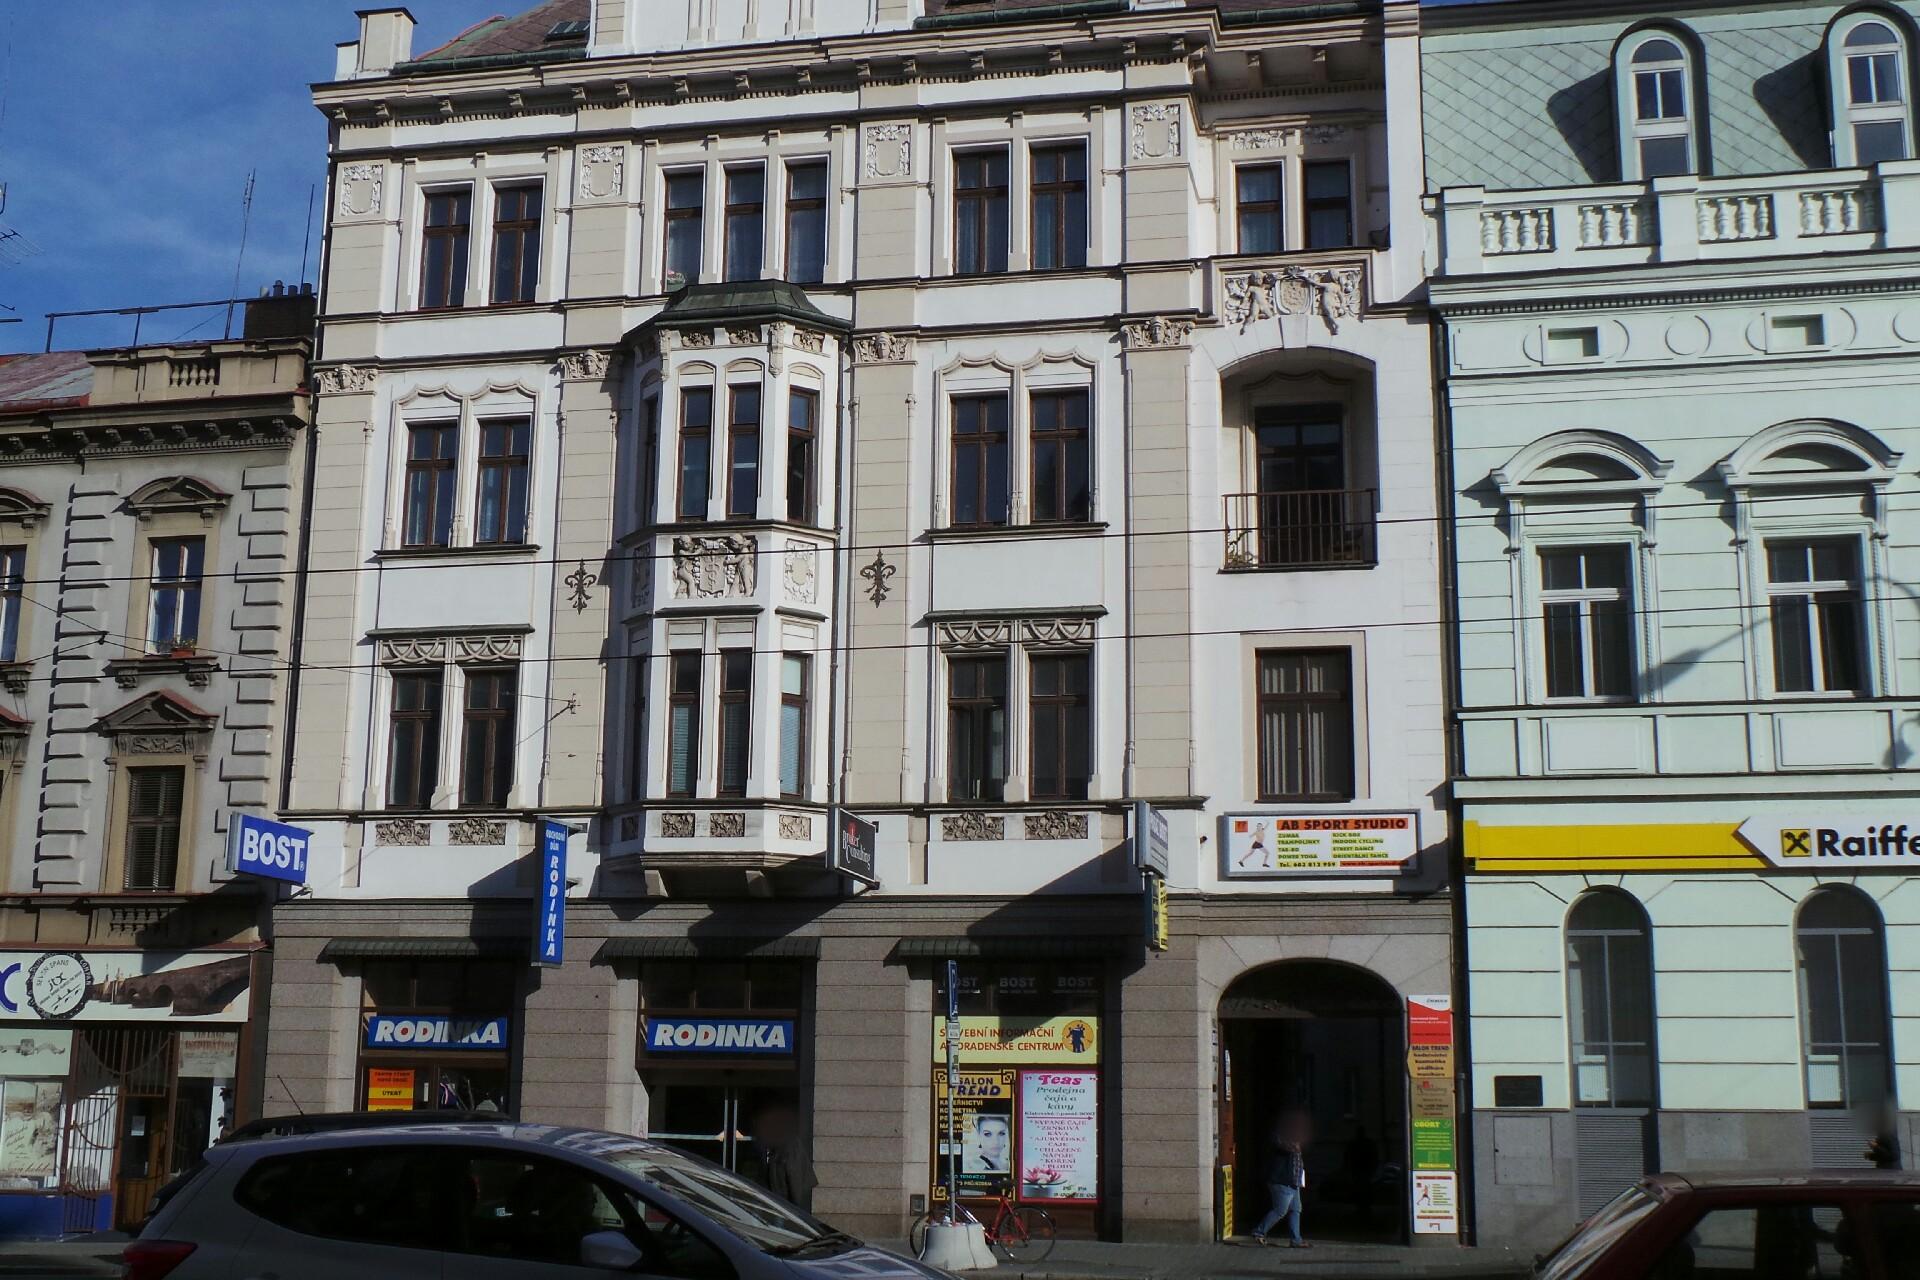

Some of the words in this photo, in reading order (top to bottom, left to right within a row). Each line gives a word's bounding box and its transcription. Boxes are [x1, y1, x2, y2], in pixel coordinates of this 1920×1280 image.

[1281, 820, 1299, 830] AB
[1304, 820, 1348, 830] SPORT
[1354, 819, 1406, 829] STUDIO
[243, 827, 306, 871] BOST
[546, 855, 559, 956] RODINKA
[1000, 976, 1036, 988] BOST
[1058, 976, 1095, 988] BOST
[375, 1020, 500, 1044] RODINKA
[654, 1023, 786, 1048] RODINKA
[939, 1026, 988, 1038] SVEBNÍ
[990, 1026, 1056, 1038] INFORMAČNÍ
[955, 1042, 1014, 1051] ORADENSKÉ
[1018, 1042, 1064, 1051] CENTRUM
[1038, 1074, 1082, 1086] Teas
[1036, 1087, 1086, 1095] Prodejna
